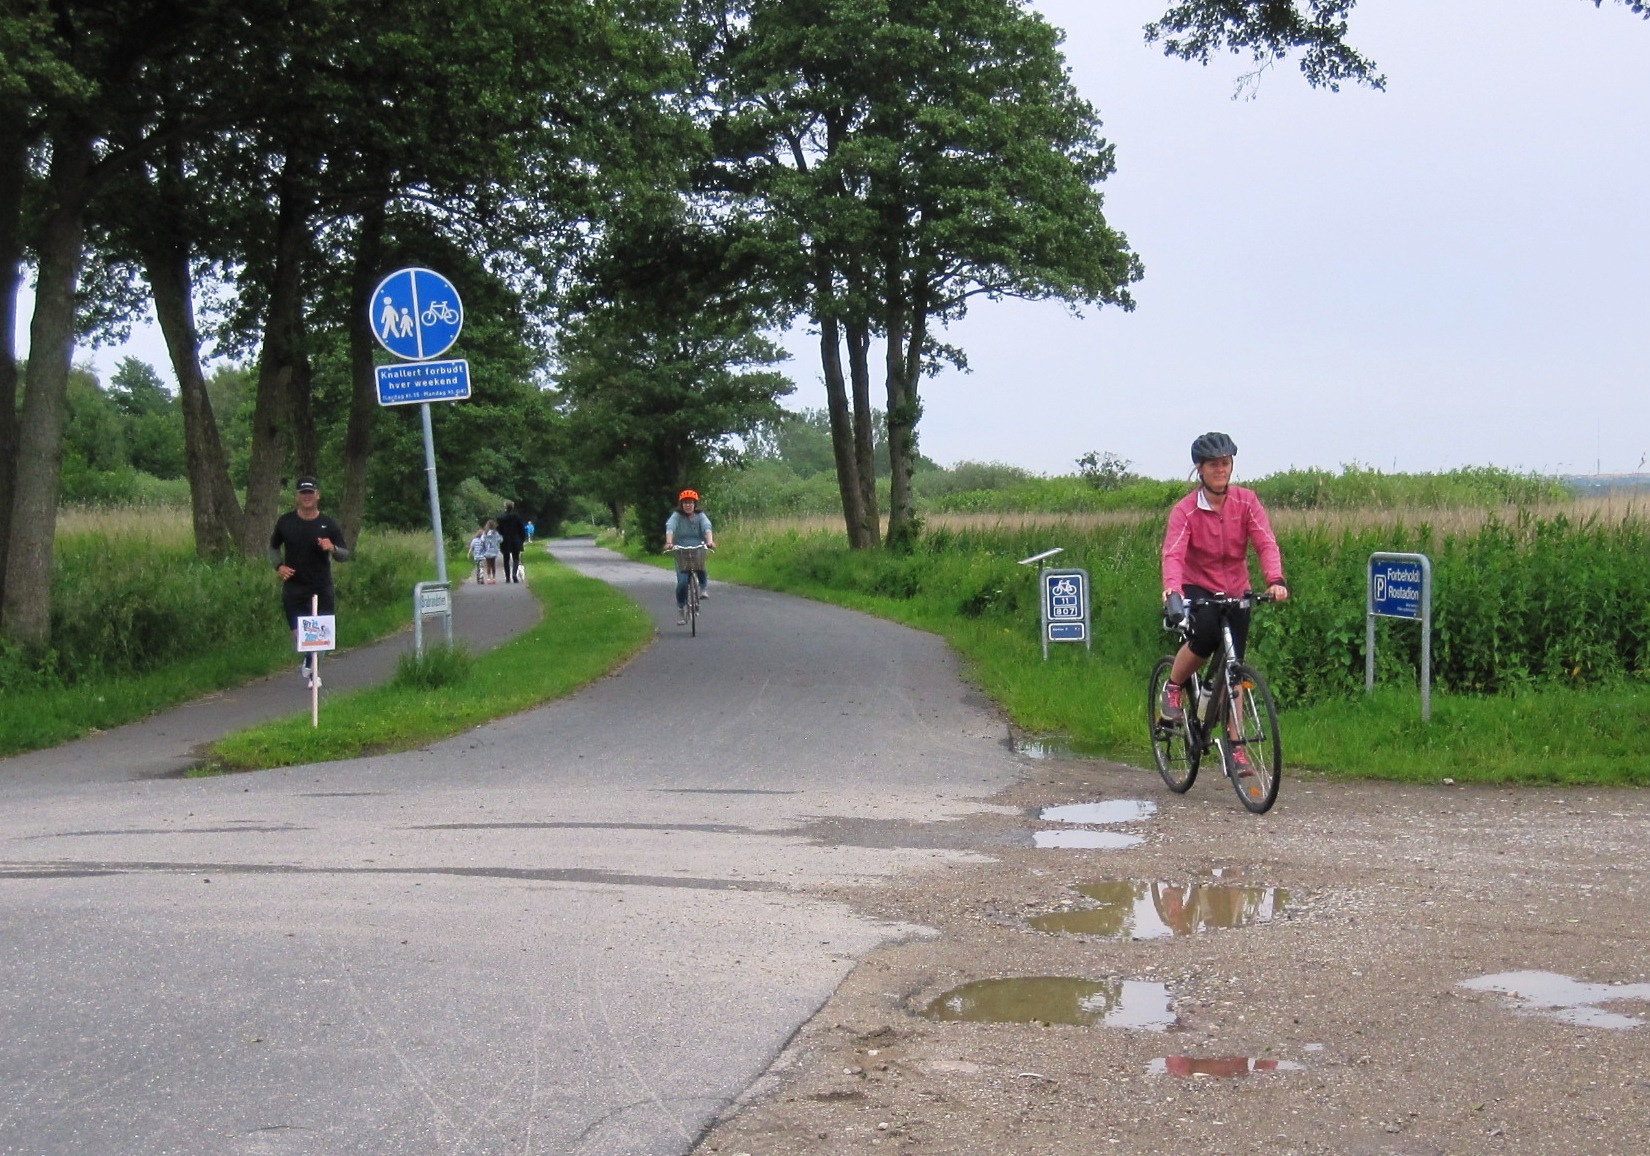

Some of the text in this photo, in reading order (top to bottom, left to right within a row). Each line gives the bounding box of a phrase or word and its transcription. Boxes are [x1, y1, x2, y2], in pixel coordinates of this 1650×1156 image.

[381, 365, 464, 379] Knallert forbudt
[389, 377, 458, 389] hver weekend
[1388, 585, 1419, 600] Rostadion
